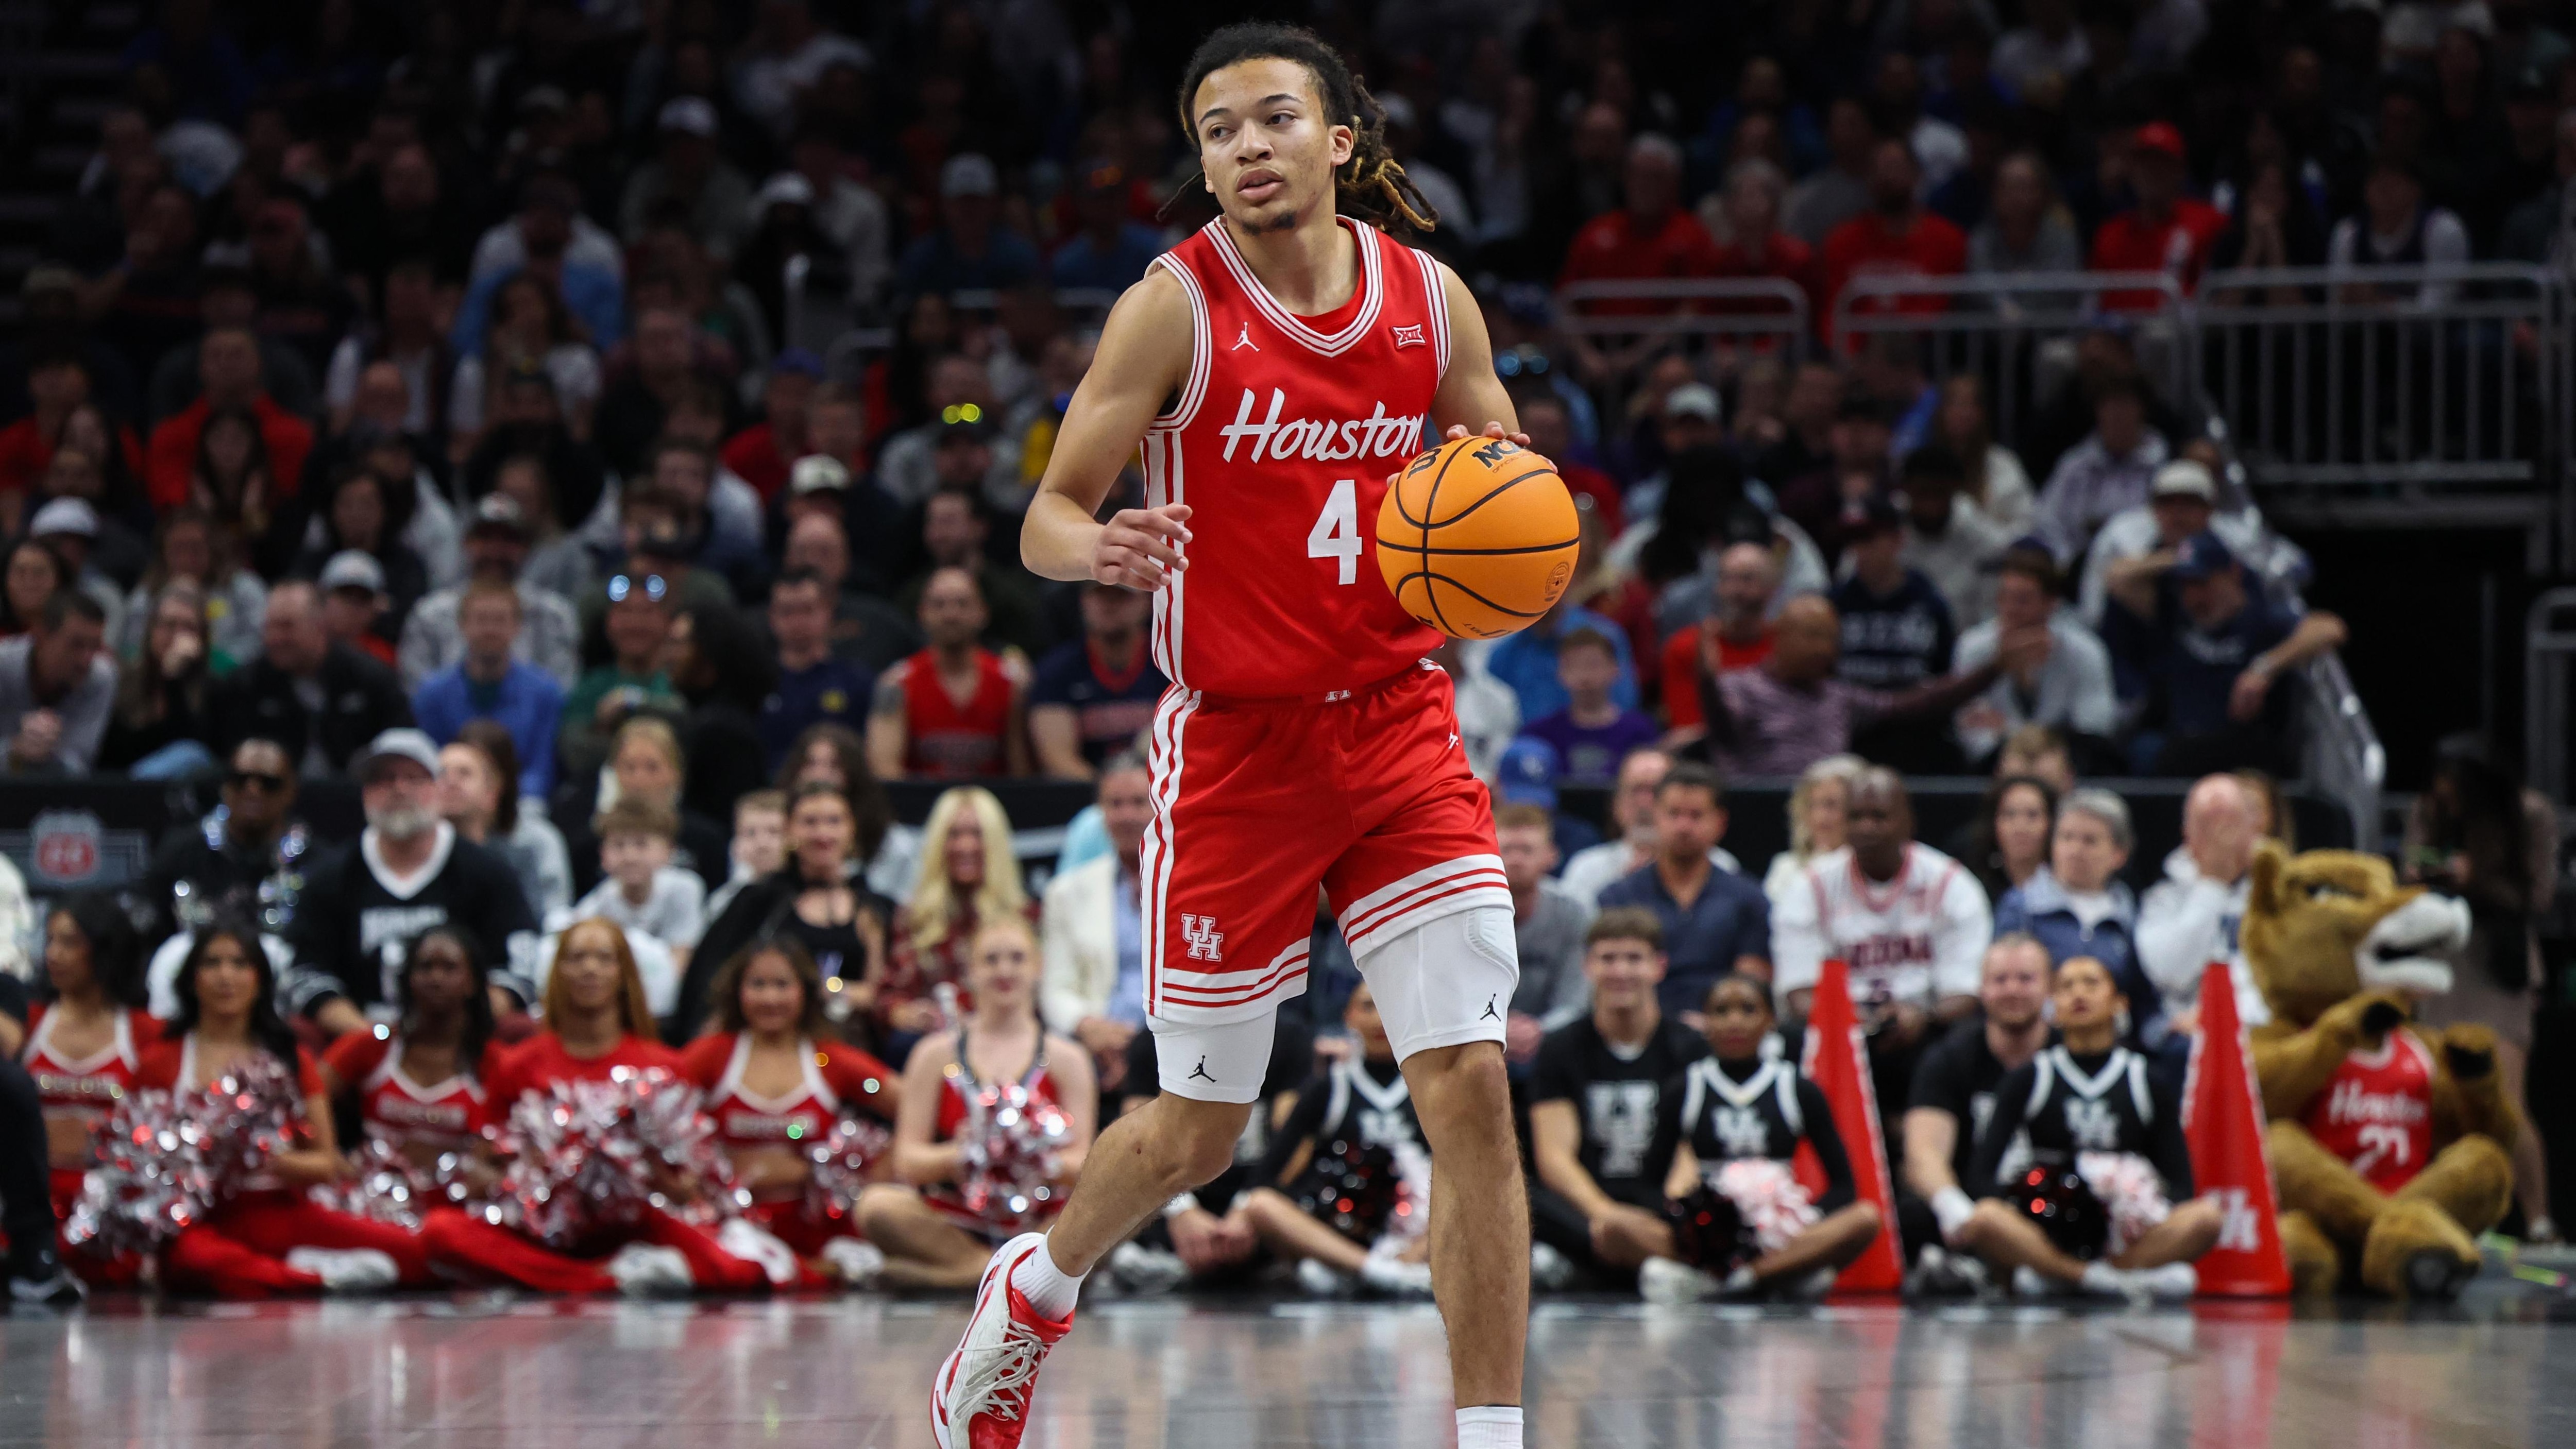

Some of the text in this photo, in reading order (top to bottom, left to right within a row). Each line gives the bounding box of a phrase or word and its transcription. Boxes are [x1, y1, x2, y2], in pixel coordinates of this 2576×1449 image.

[1219, 387, 1423, 464] Houston
[1308, 480, 1362, 585] 4
[1181, 913, 1223, 962] UH
